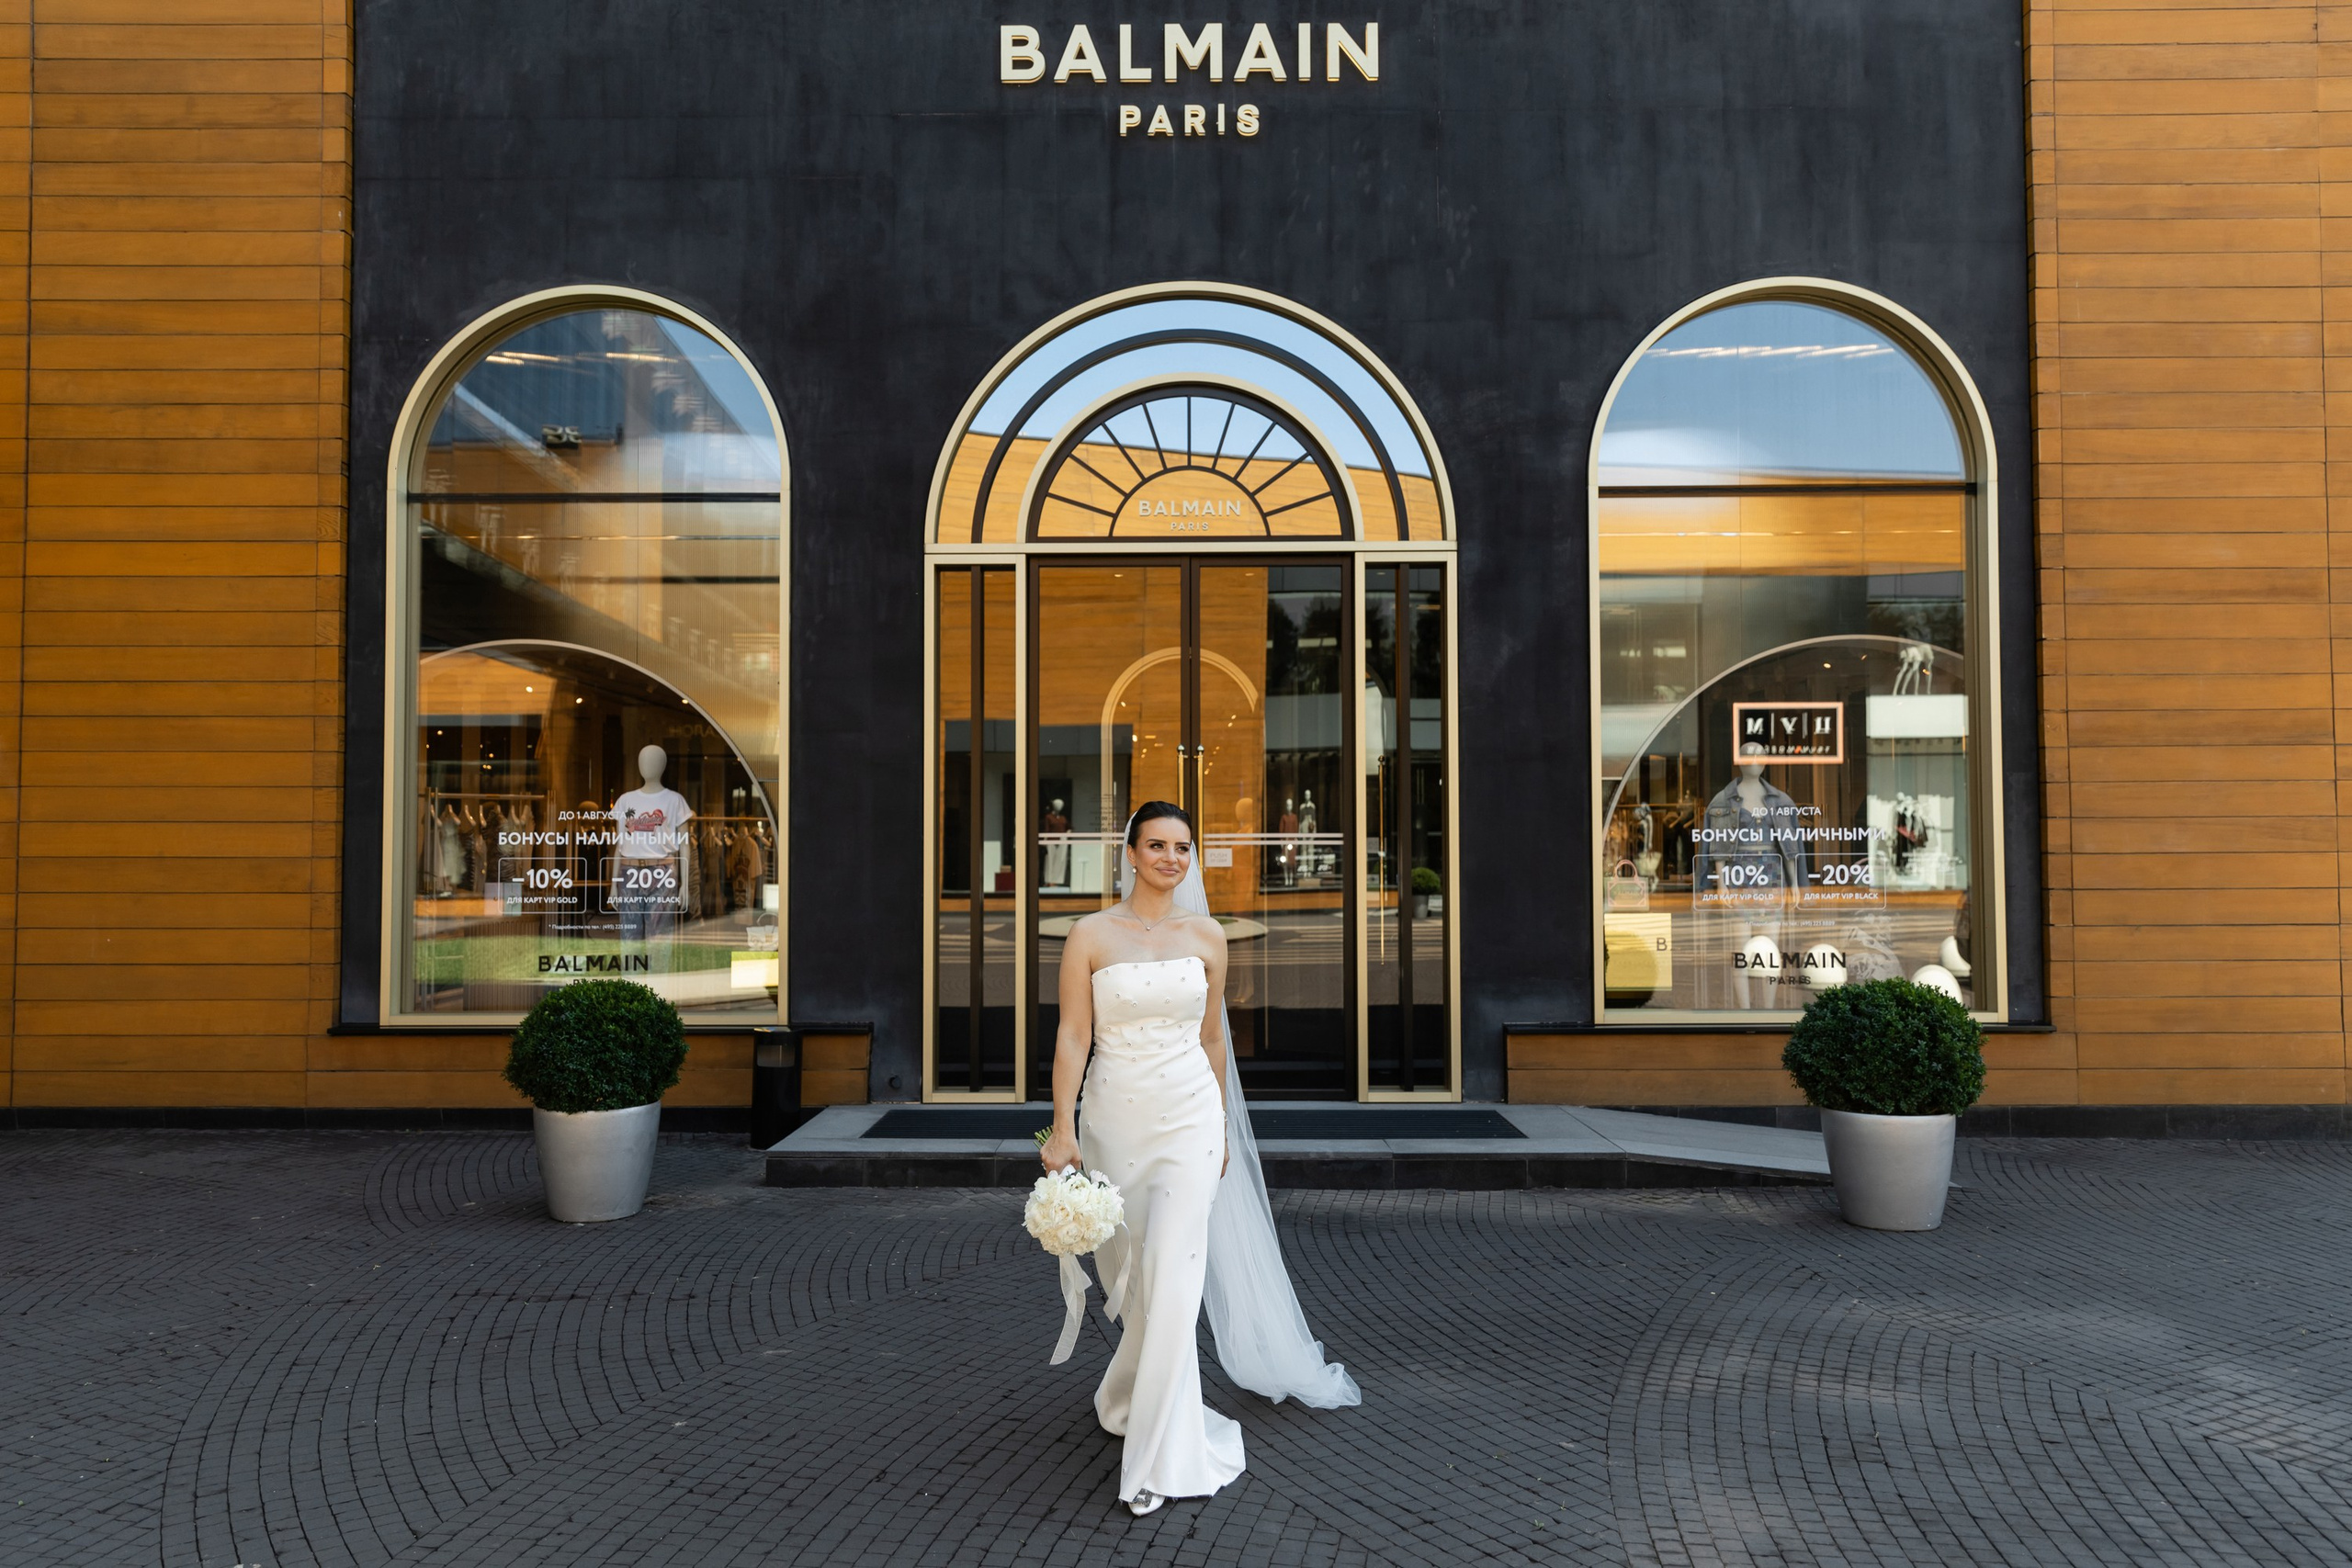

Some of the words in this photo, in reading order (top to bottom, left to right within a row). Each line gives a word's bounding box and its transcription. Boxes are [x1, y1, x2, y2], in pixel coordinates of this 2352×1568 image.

[1000, 22, 1379, 83] BALMAIN
[1119, 103, 1261, 137] PARIS
[1138, 500, 1241, 517] BALMAIN
[1170, 522, 1210, 531] PARIS
[558, 811, 575, 821] ДО
[576, 811, 581, 819] 1
[582, 811, 627, 820] АВГУСТА
[1751, 807, 1769, 818] ДО
[1770, 807, 1774, 816] 1
[1776, 807, 1822, 817] АВГУСТА
[498, 831, 569, 846] БОНУСЫ
[576, 831, 689, 845] НАЛИЧНЫМИ
[1691, 829, 1763, 843] БОНУСЫ
[1770, 828, 1884, 842] НАЛИЧНЫМИ
[512, 868, 573, 889] -10%
[612, 868, 676, 889] -20%
[1707, 865, 1769, 886] -10%
[1807, 864, 1873, 886] -20%
[1855, 892, 1879, 900] BLACK
[538, 954, 649, 972] BALMAIN
[1734, 952, 1847, 969] BALMAIN
[1770, 976, 1812, 986] PARIS
